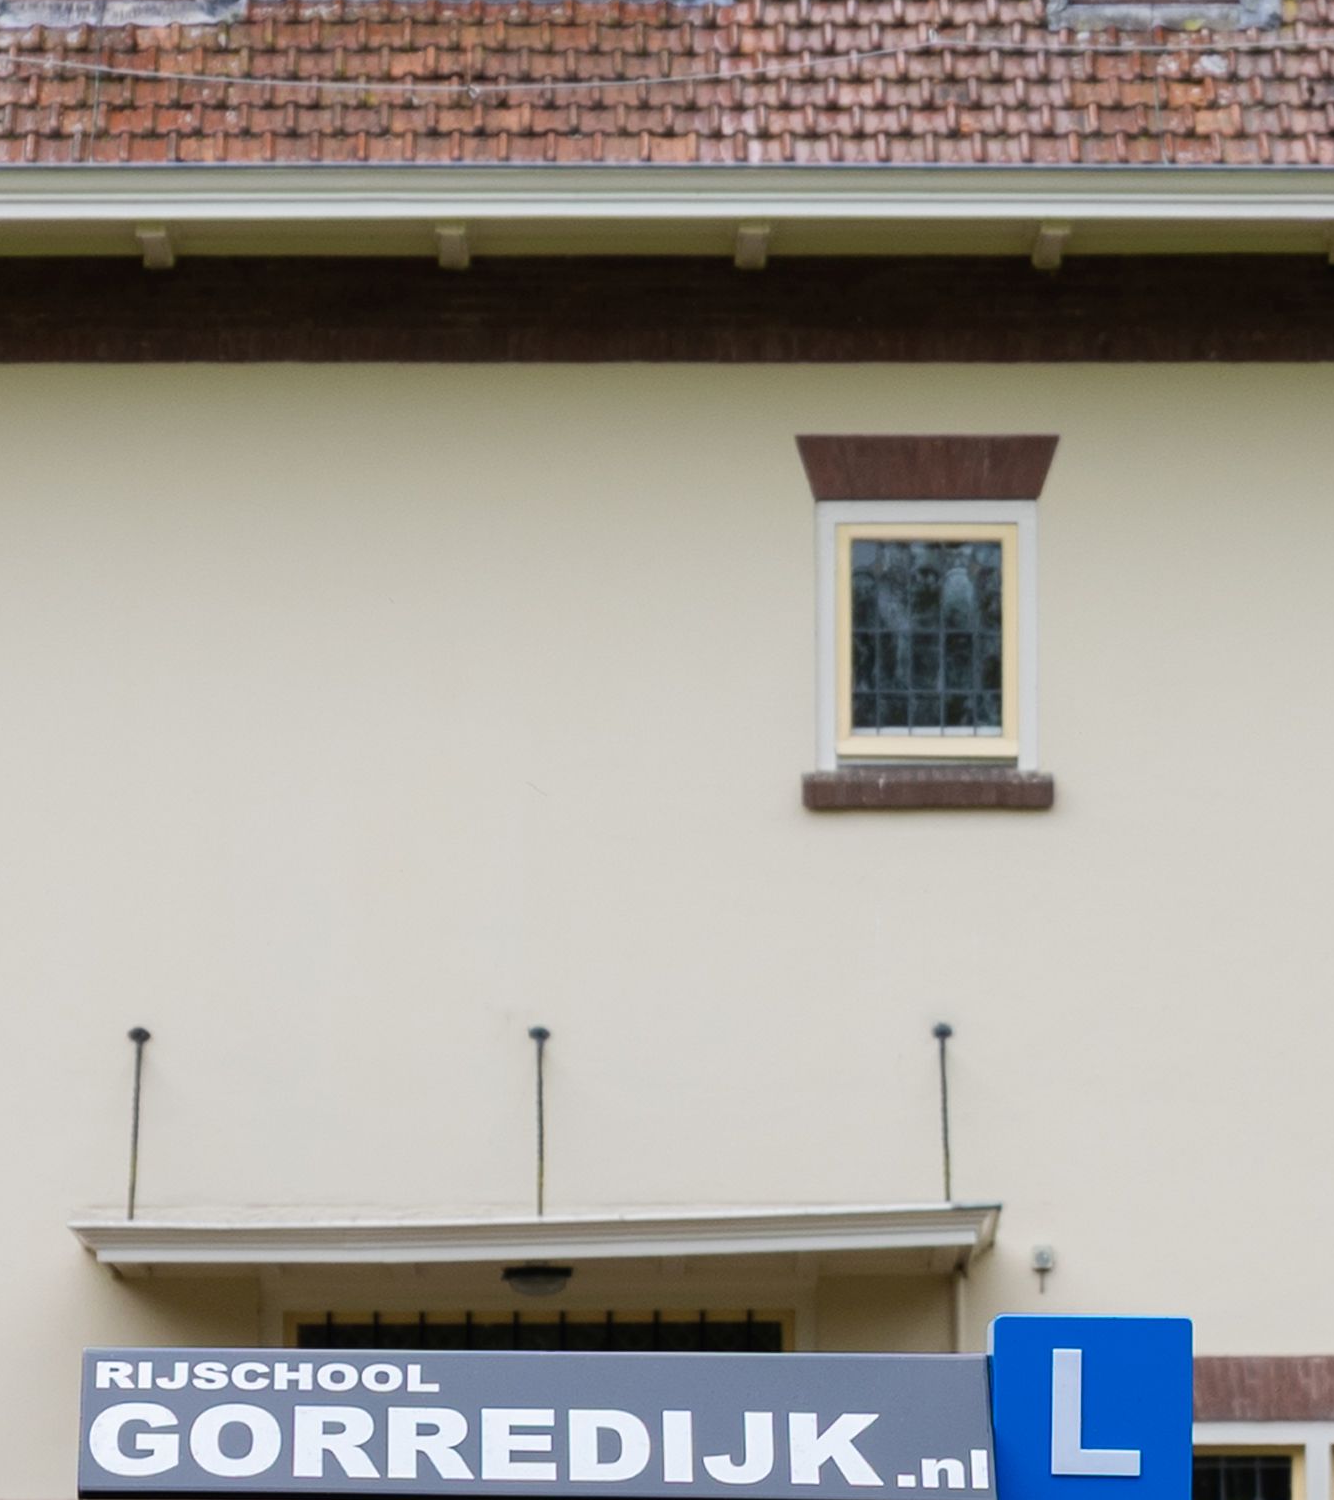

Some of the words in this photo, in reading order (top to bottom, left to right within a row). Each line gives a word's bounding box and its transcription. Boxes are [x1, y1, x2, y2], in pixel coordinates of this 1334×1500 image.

[95, 1360, 440, 1393] RIJSCHOOL
[1051, 1347, 1141, 1476] L
[88, 1402, 989, 1489] GORREDIJK.nl
